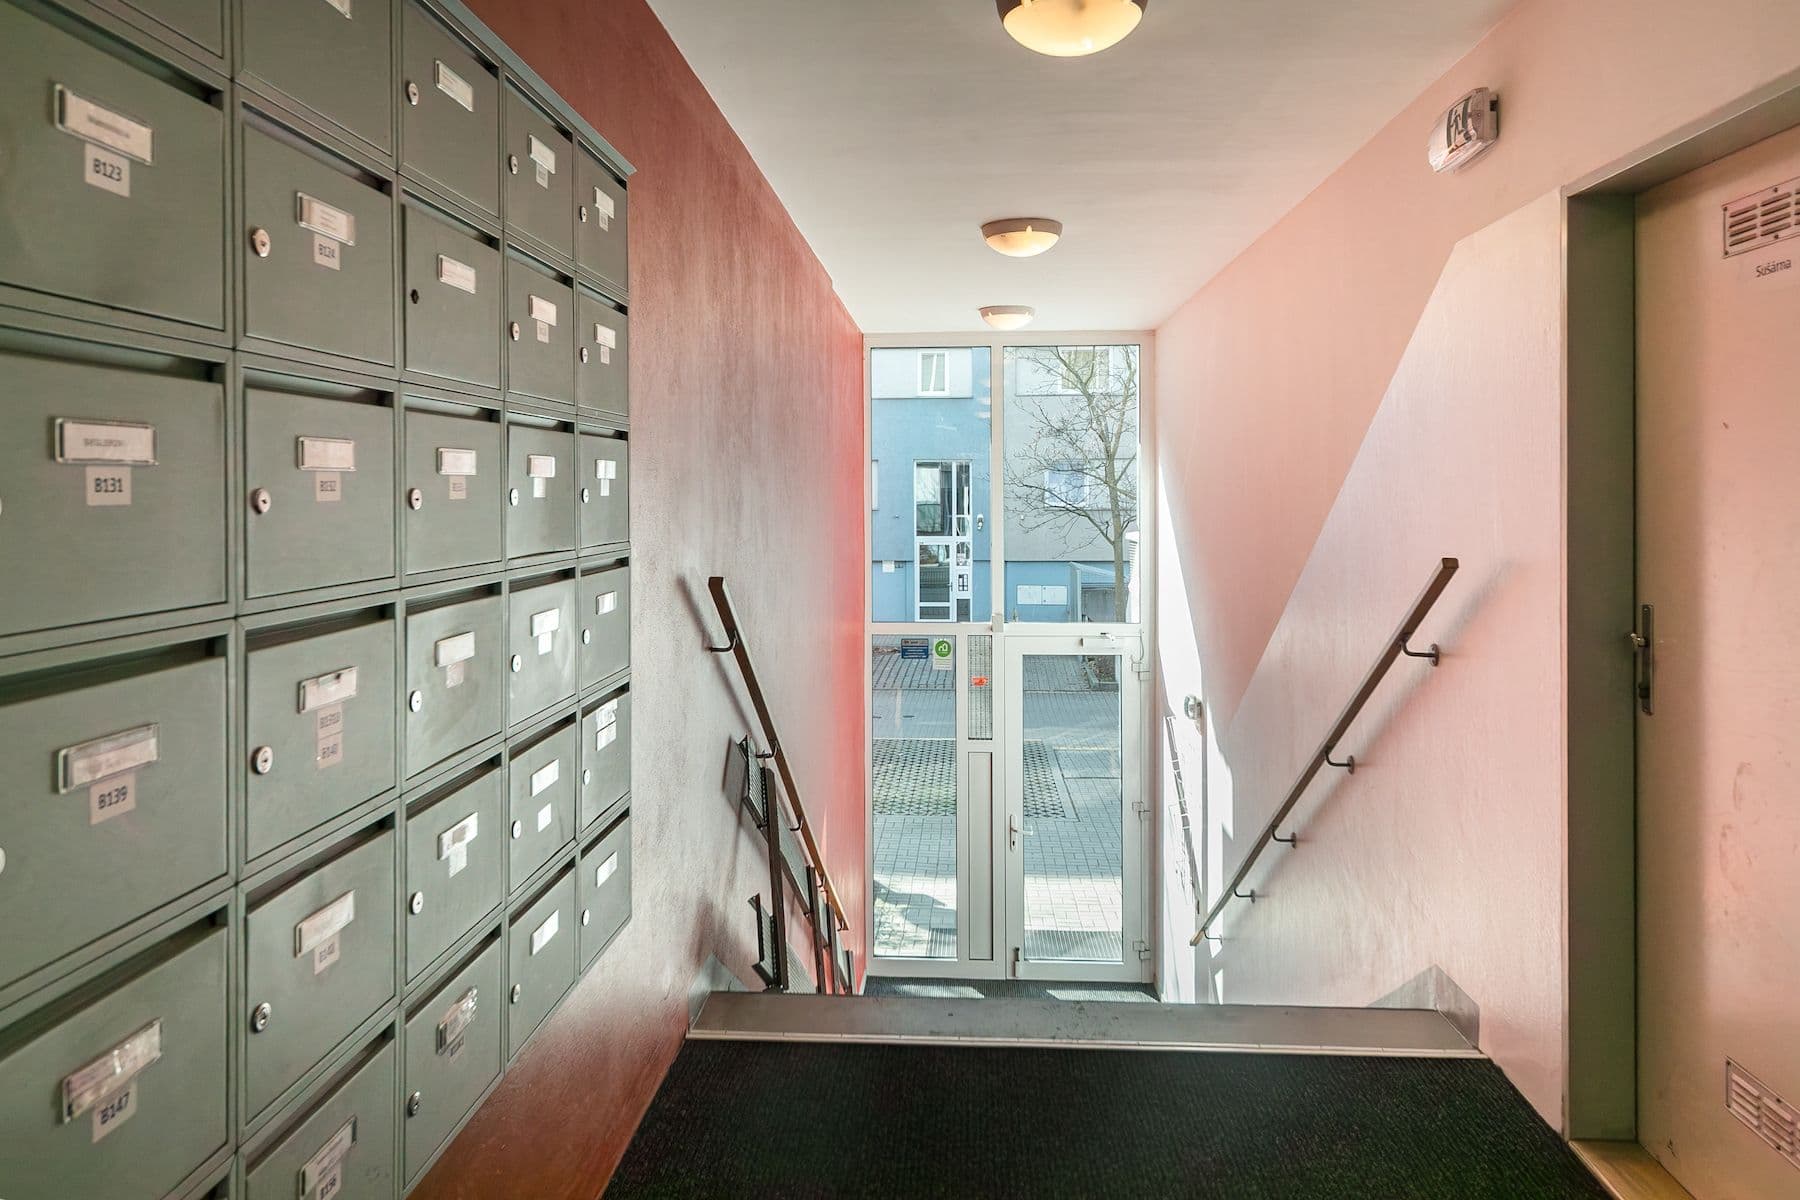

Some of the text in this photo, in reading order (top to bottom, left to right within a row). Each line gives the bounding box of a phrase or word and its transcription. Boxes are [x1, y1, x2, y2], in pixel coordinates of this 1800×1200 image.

[93, 158, 122, 182] B123
[1756, 259, 1792, 278] Sušárna
[94, 477, 124, 493] B131
[98, 785, 128, 810] B139
